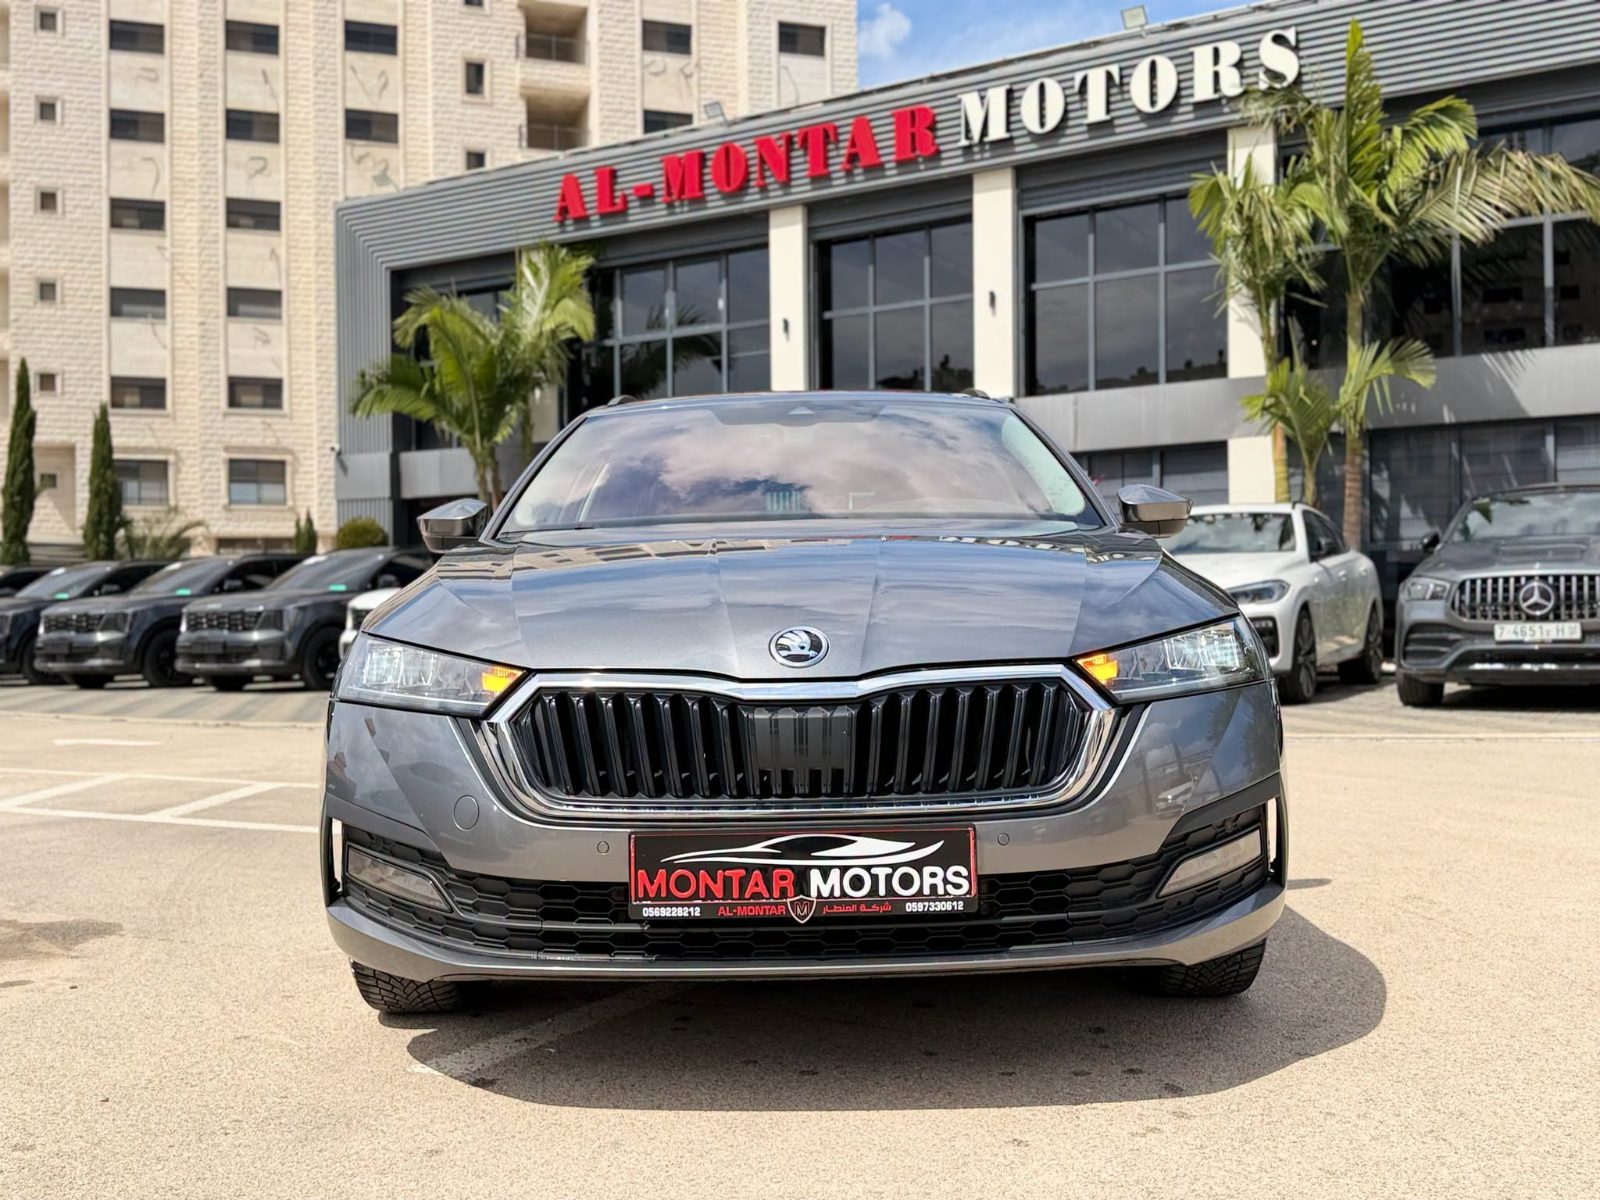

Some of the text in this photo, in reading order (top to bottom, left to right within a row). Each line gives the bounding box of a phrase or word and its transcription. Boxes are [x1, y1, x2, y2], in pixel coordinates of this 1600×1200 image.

[552, 26, 1300, 223] AL-MONTAR MOTORS
[637, 865, 970, 898] MONTAR MOTORS
[642, 905, 786, 917] 0569228212 AL-MONTAR
[905, 901, 964, 912] 0597330612
